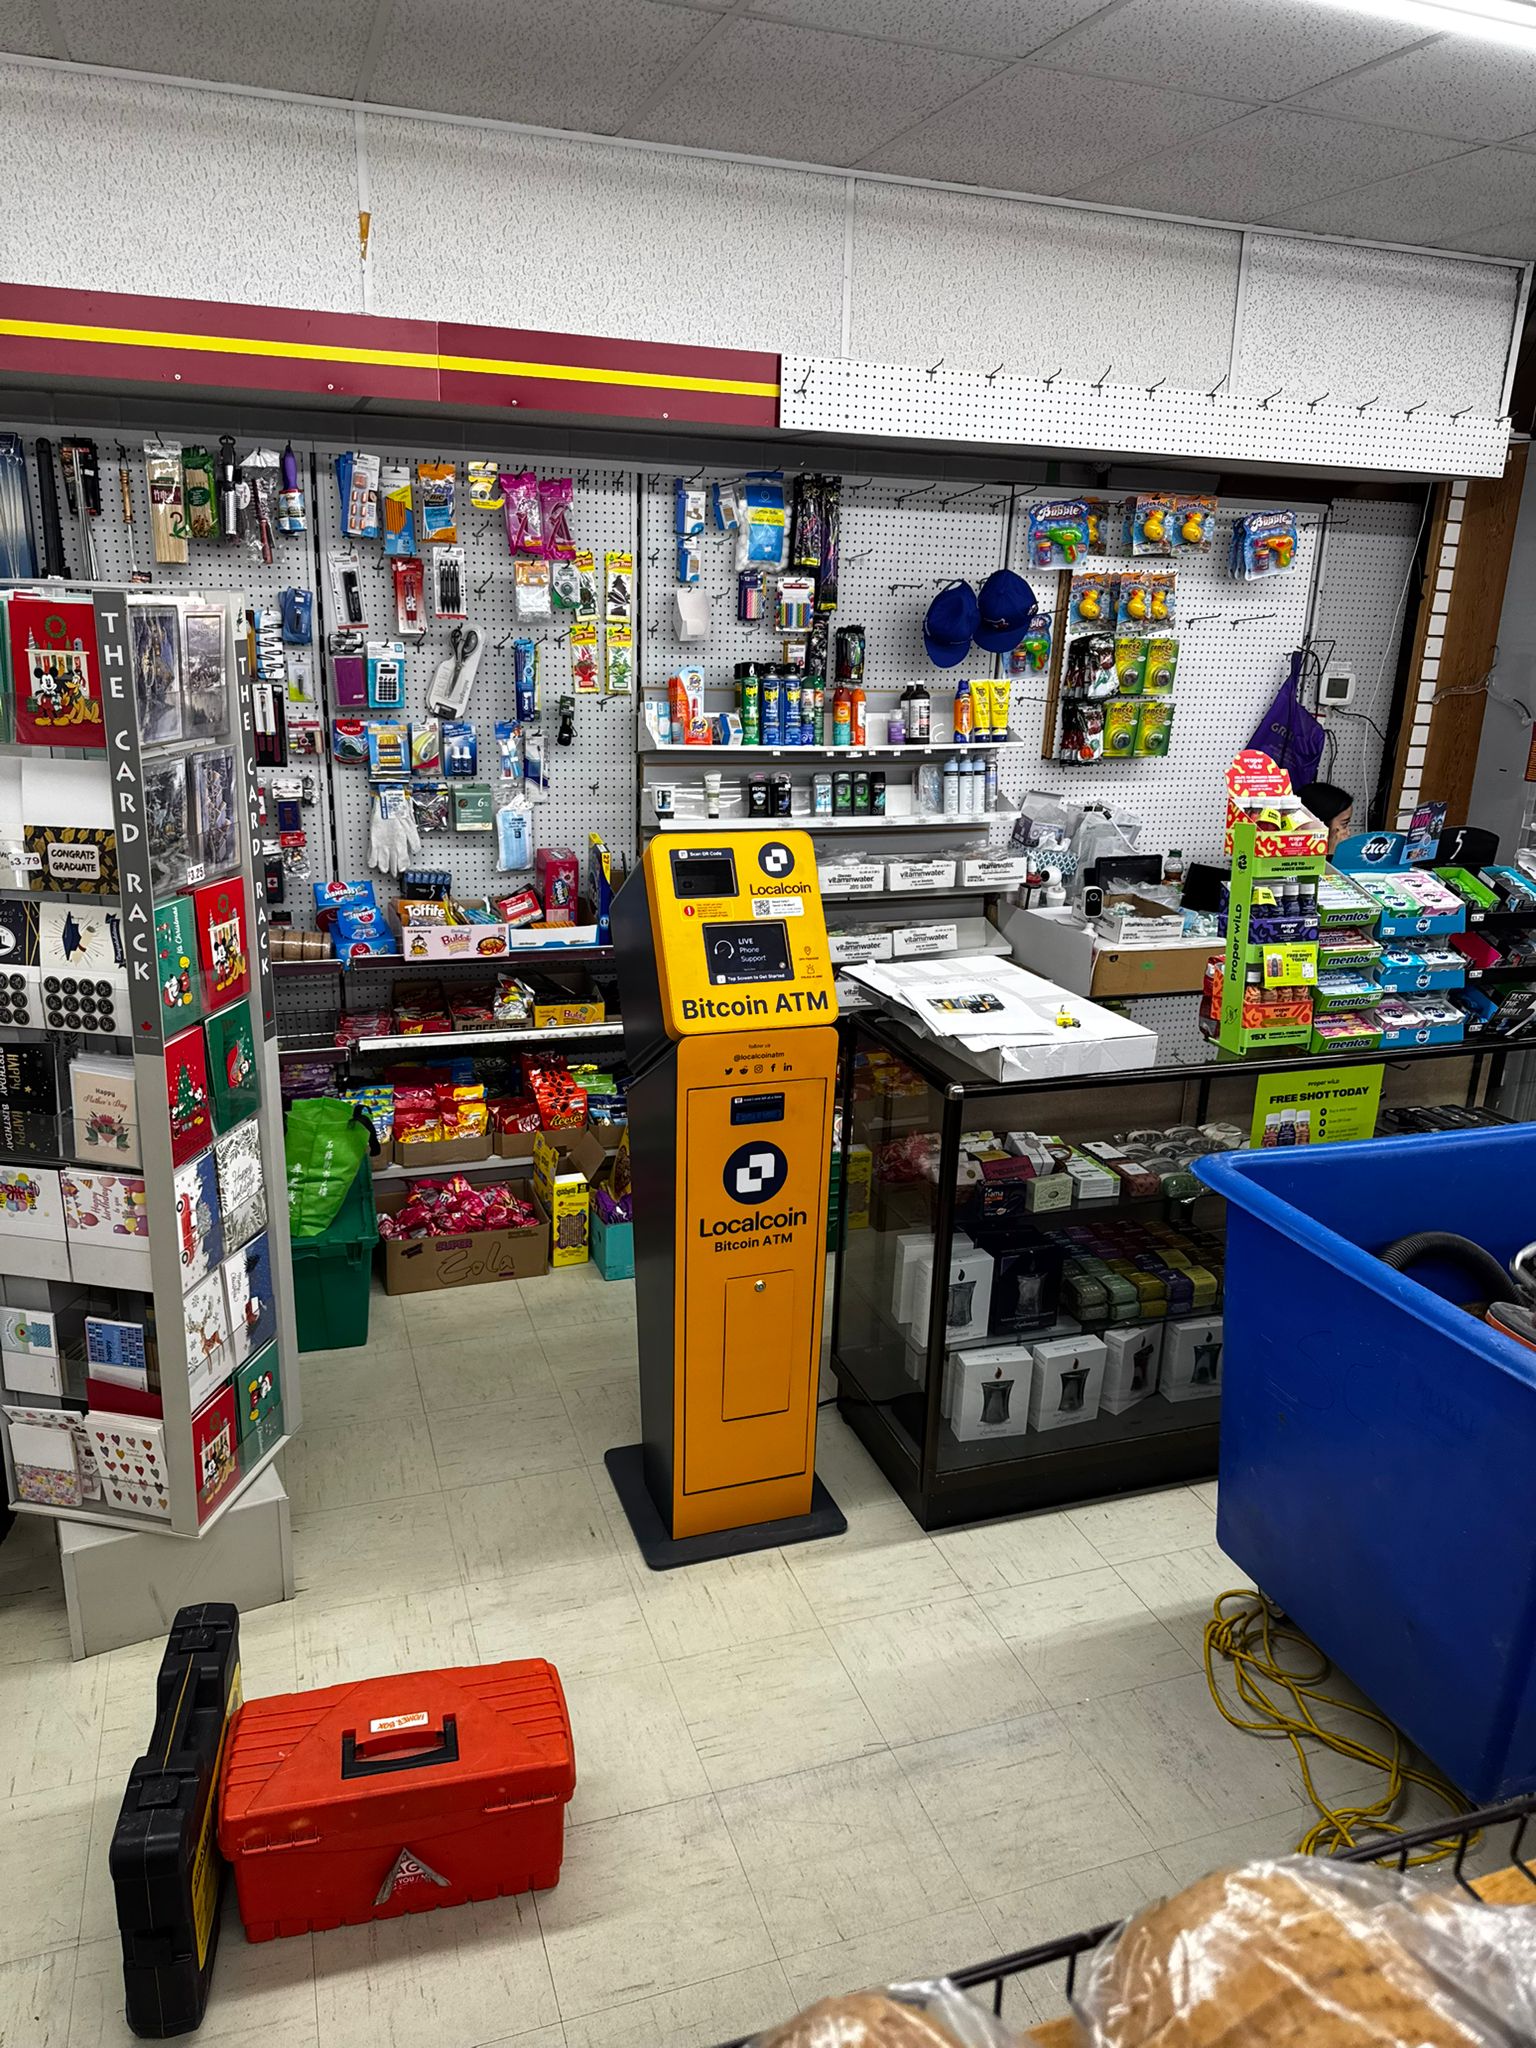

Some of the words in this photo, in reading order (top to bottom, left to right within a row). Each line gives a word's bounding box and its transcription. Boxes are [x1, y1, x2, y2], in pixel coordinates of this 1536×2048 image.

[1037, 504, 1079, 521] Bubble
[101, 612, 124, 699] THE
[115, 729, 139, 843] CARD
[127, 872, 150, 981] RACK
[238, 657, 250, 731] THE
[247, 757, 260, 856] CARD
[257, 881, 269, 975] RACK
[51, 849, 96, 860] CONGRATS
[10, 857, 40, 866] $3.79
[53, 862, 97, 872] GRADUATE
[750, 882, 811, 895] Localcoin
[405, 904, 446, 918] Toffife
[1327, 913, 1369, 923] mentos
[741, 954, 766, 962] Support
[1328, 955, 1370, 966] mentos
[682, 995, 768, 1019] Bitcoin
[776, 991, 828, 1013] ATM
[1329, 997, 1371, 1008] mentos
[1328, 1039, 1371, 1050] mentos
[734, 1052, 784, 1062] @localcoinatm
[96, 1088, 115, 1098] Happy
[1270, 1095, 1298, 1104] FREE
[1299, 1091, 1331, 1102] SHOT
[1333, 1087, 1369, 1098] TODAY
[2, 1103, 14, 1151] BIRTHDAY
[700, 1207, 807, 1238] Localcoin
[436, 1239, 472, 1252] SUPER
[715, 1237, 759, 1253] Bitcoin
[763, 1233, 793, 1246] ATM
[399, 1876, 414, 1885] YOU
